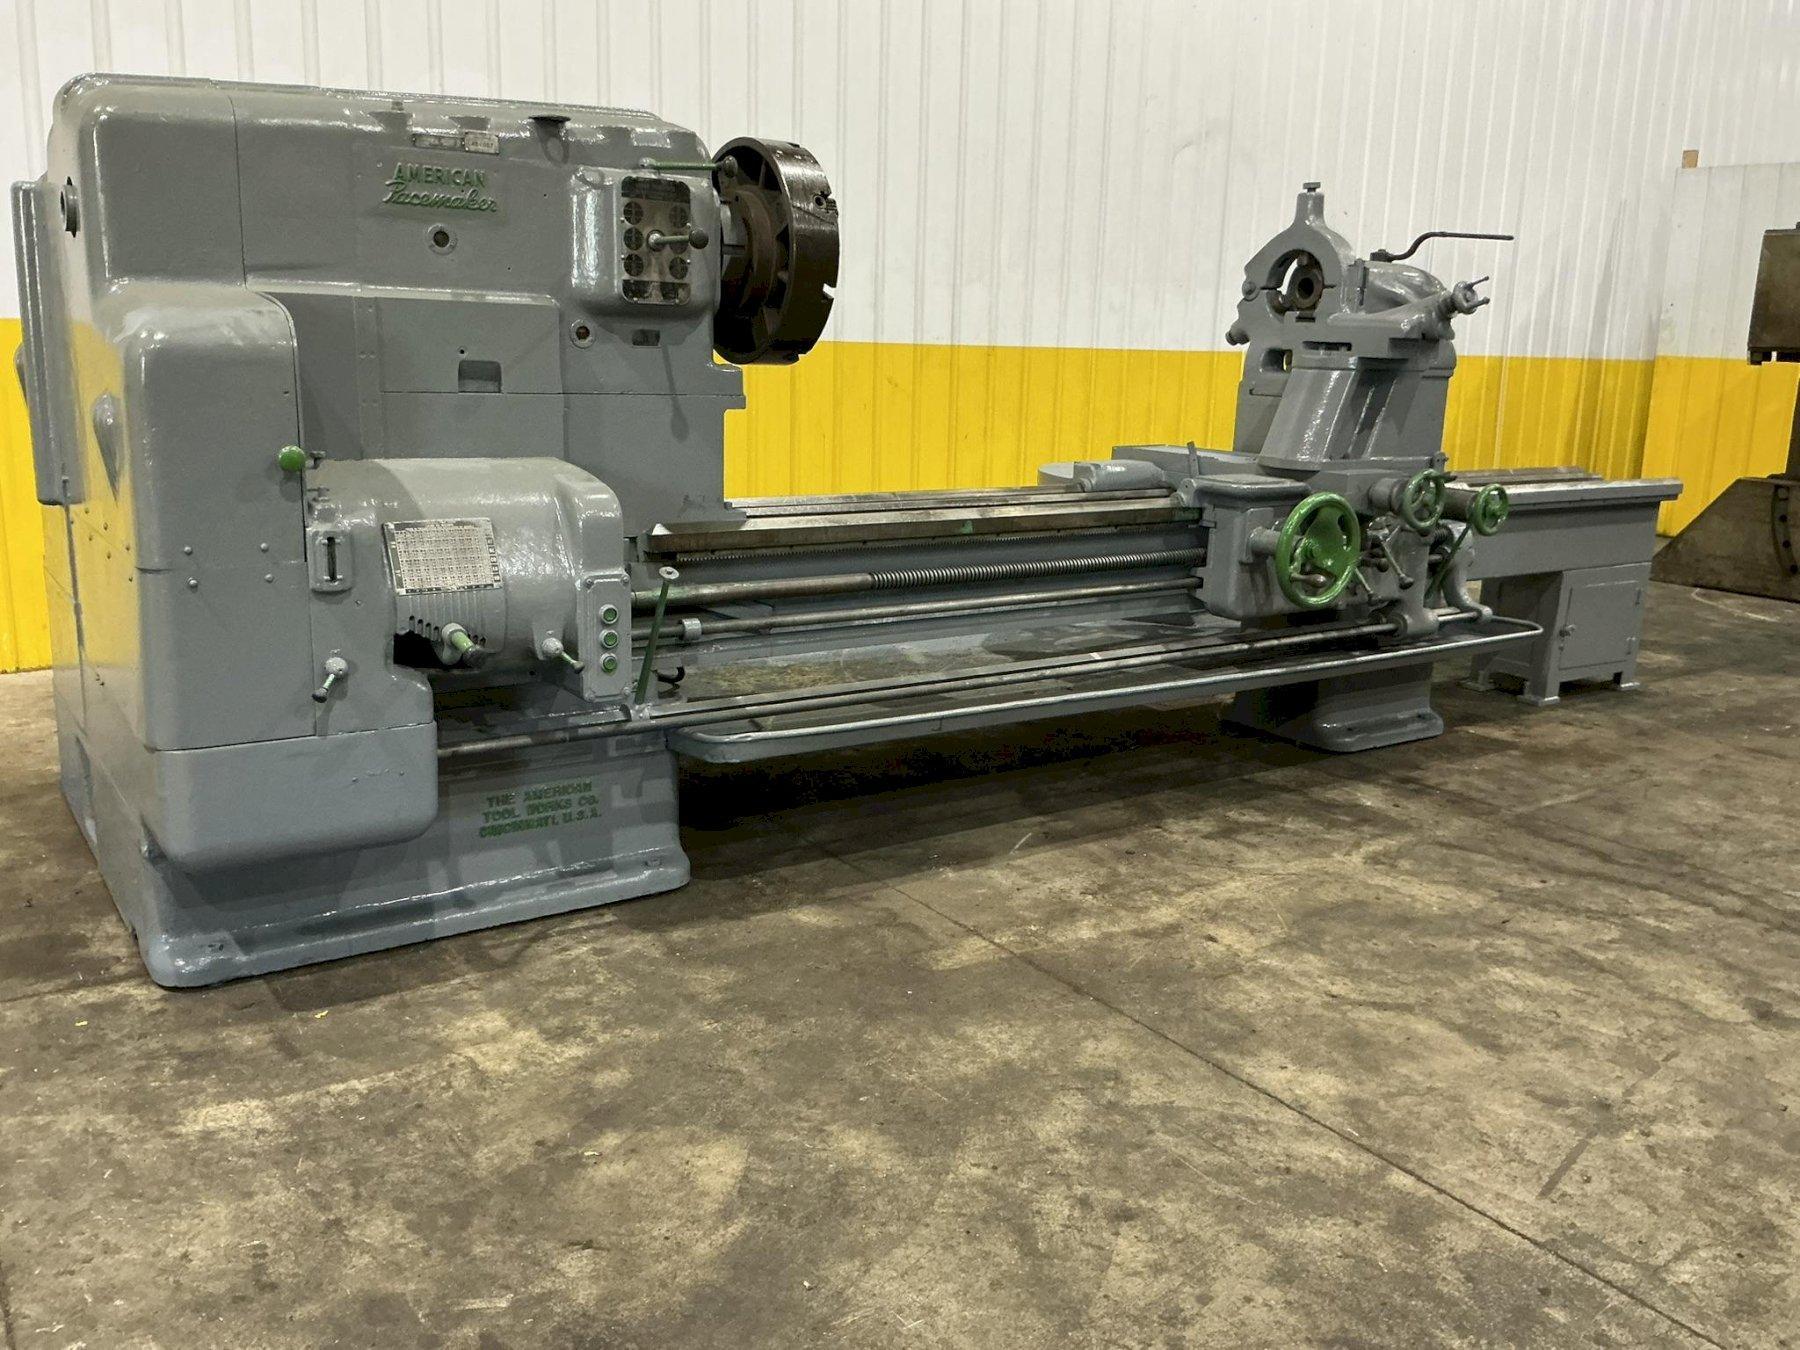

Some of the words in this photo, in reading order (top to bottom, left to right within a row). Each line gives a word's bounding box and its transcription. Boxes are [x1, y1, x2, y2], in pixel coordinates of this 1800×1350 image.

[393, 162, 486, 187] AMERICAN
[382, 179, 497, 212] Pacemaker
[486, 792, 518, 807] THE
[523, 780, 592, 801] AMERICAN
[482, 807, 519, 823] TOOL
